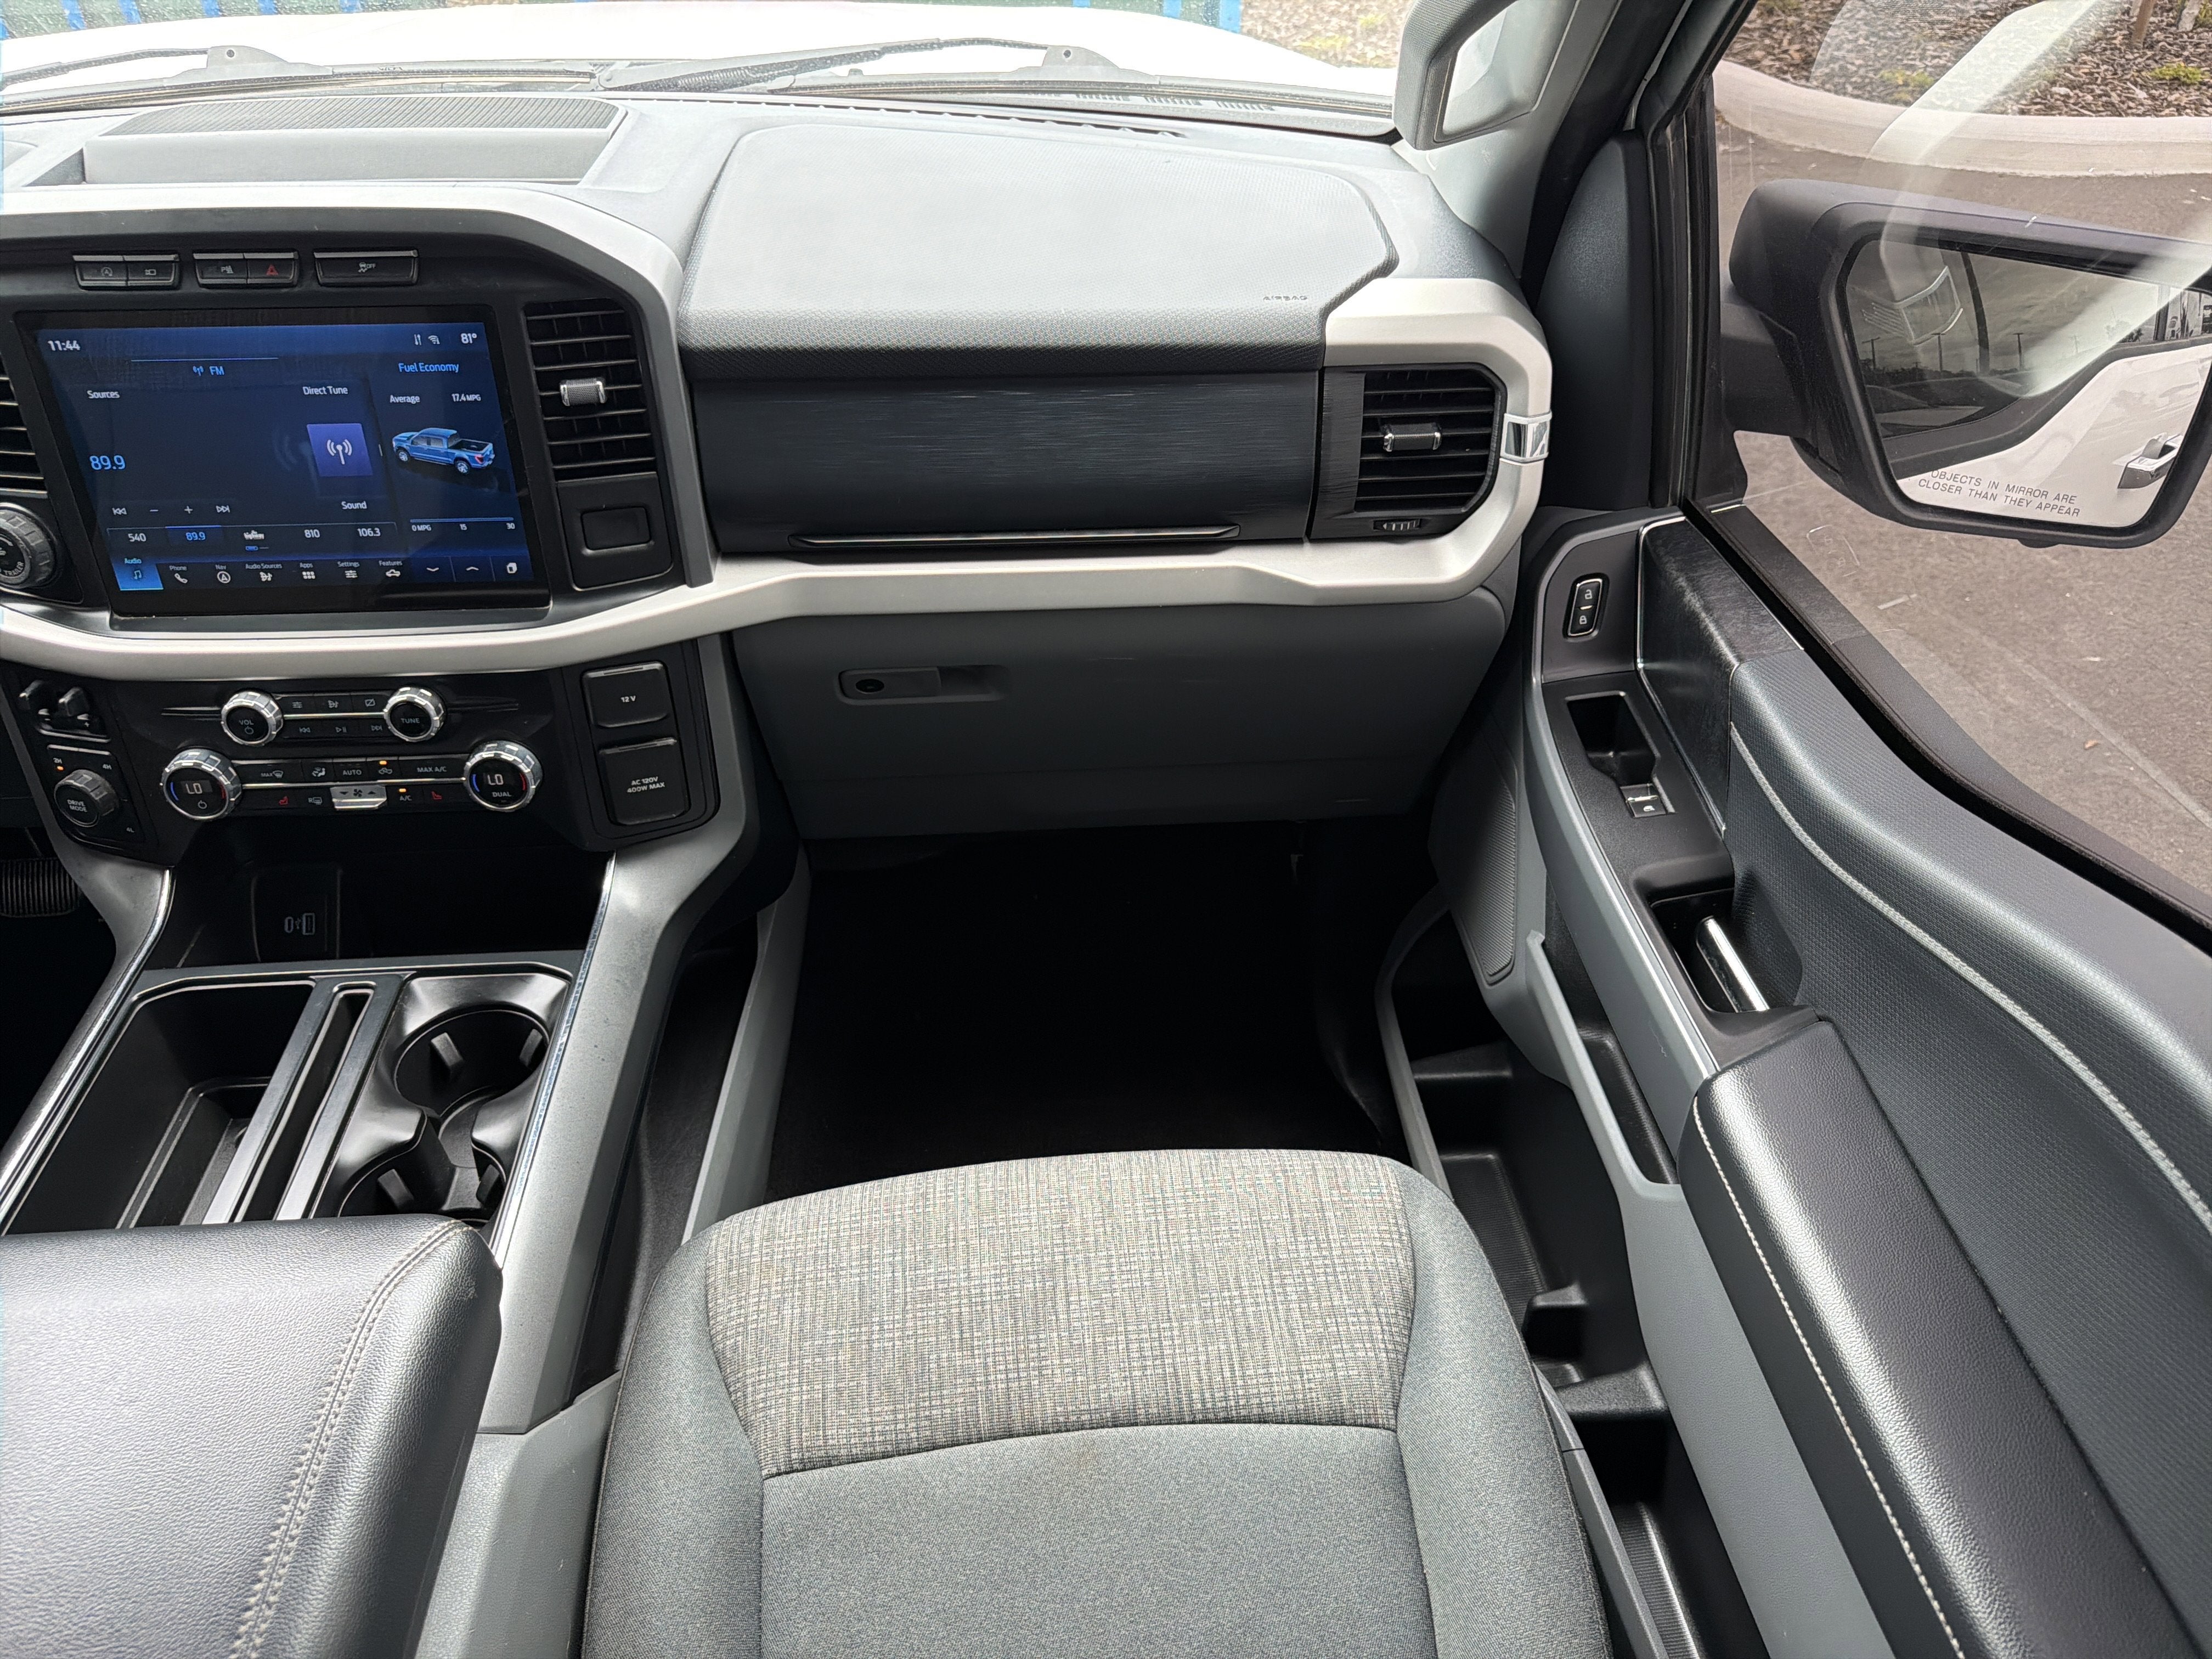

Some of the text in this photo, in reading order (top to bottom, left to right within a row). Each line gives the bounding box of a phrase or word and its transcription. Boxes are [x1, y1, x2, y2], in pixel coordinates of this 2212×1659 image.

[48, 340, 81, 351] 11:44
[209, 365, 225, 376] FM
[398, 362, 459, 373] Fuel Economy
[87, 390, 120, 399] Sources
[303, 386, 348, 395] Direct Tune
[390, 395, 420, 404] Average
[452, 394, 466, 402] 17.4
[89, 455, 126, 470] 89.9
[1931, 470, 2077, 504] OBJECTS IN MIRROR ARE
[1918, 478, 2080, 517] CLOSER THAN THEY APPEAR
[341, 501, 367, 510] Sound
[185, 532, 206, 541] 89.9
[304, 529, 320, 538] 810
[357, 528, 381, 537] 106.3
[128, 533, 146, 542] 540
[487, 774, 504, 785] LO
[186, 783, 202, 794] LO
[627, 785, 648, 793] 400W
[67, 799, 85, 808] DRIVE
[69, 804, 88, 812] MODE
